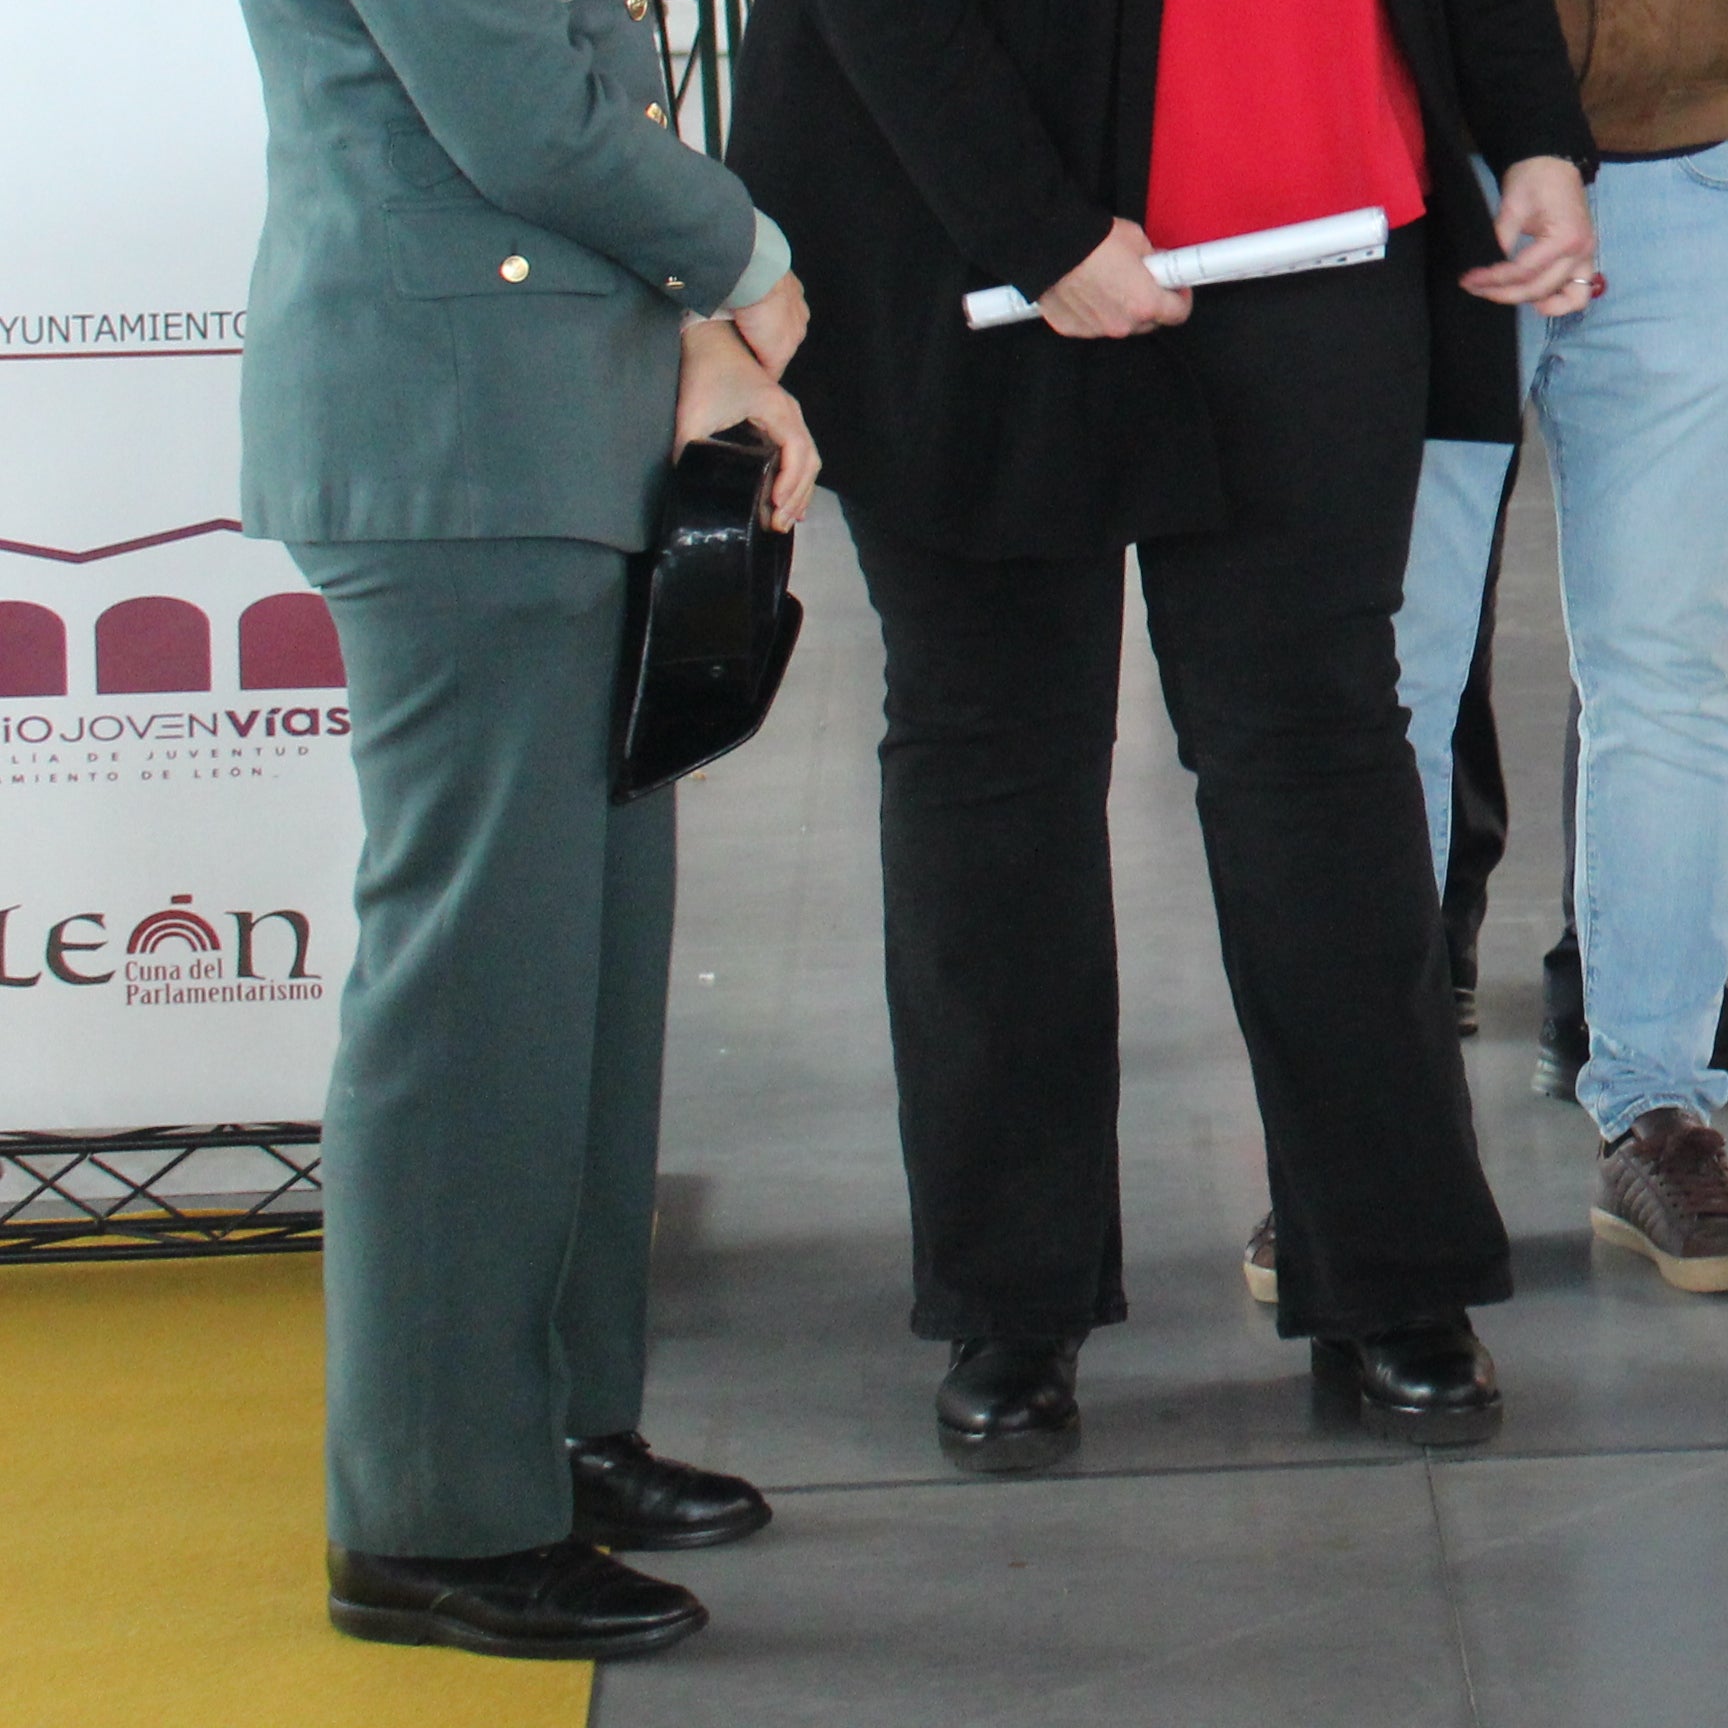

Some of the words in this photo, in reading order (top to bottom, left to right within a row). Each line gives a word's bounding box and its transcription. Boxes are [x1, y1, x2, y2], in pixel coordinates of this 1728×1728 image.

[87, 752, 120, 763] DE
[146, 746, 310, 762] JUVENTUD
[141, 771, 171, 782] DE
[125, 960, 181, 983] Cuna
[189, 958, 223, 980] del
[125, 980, 323, 1005] Parlamentarismo
